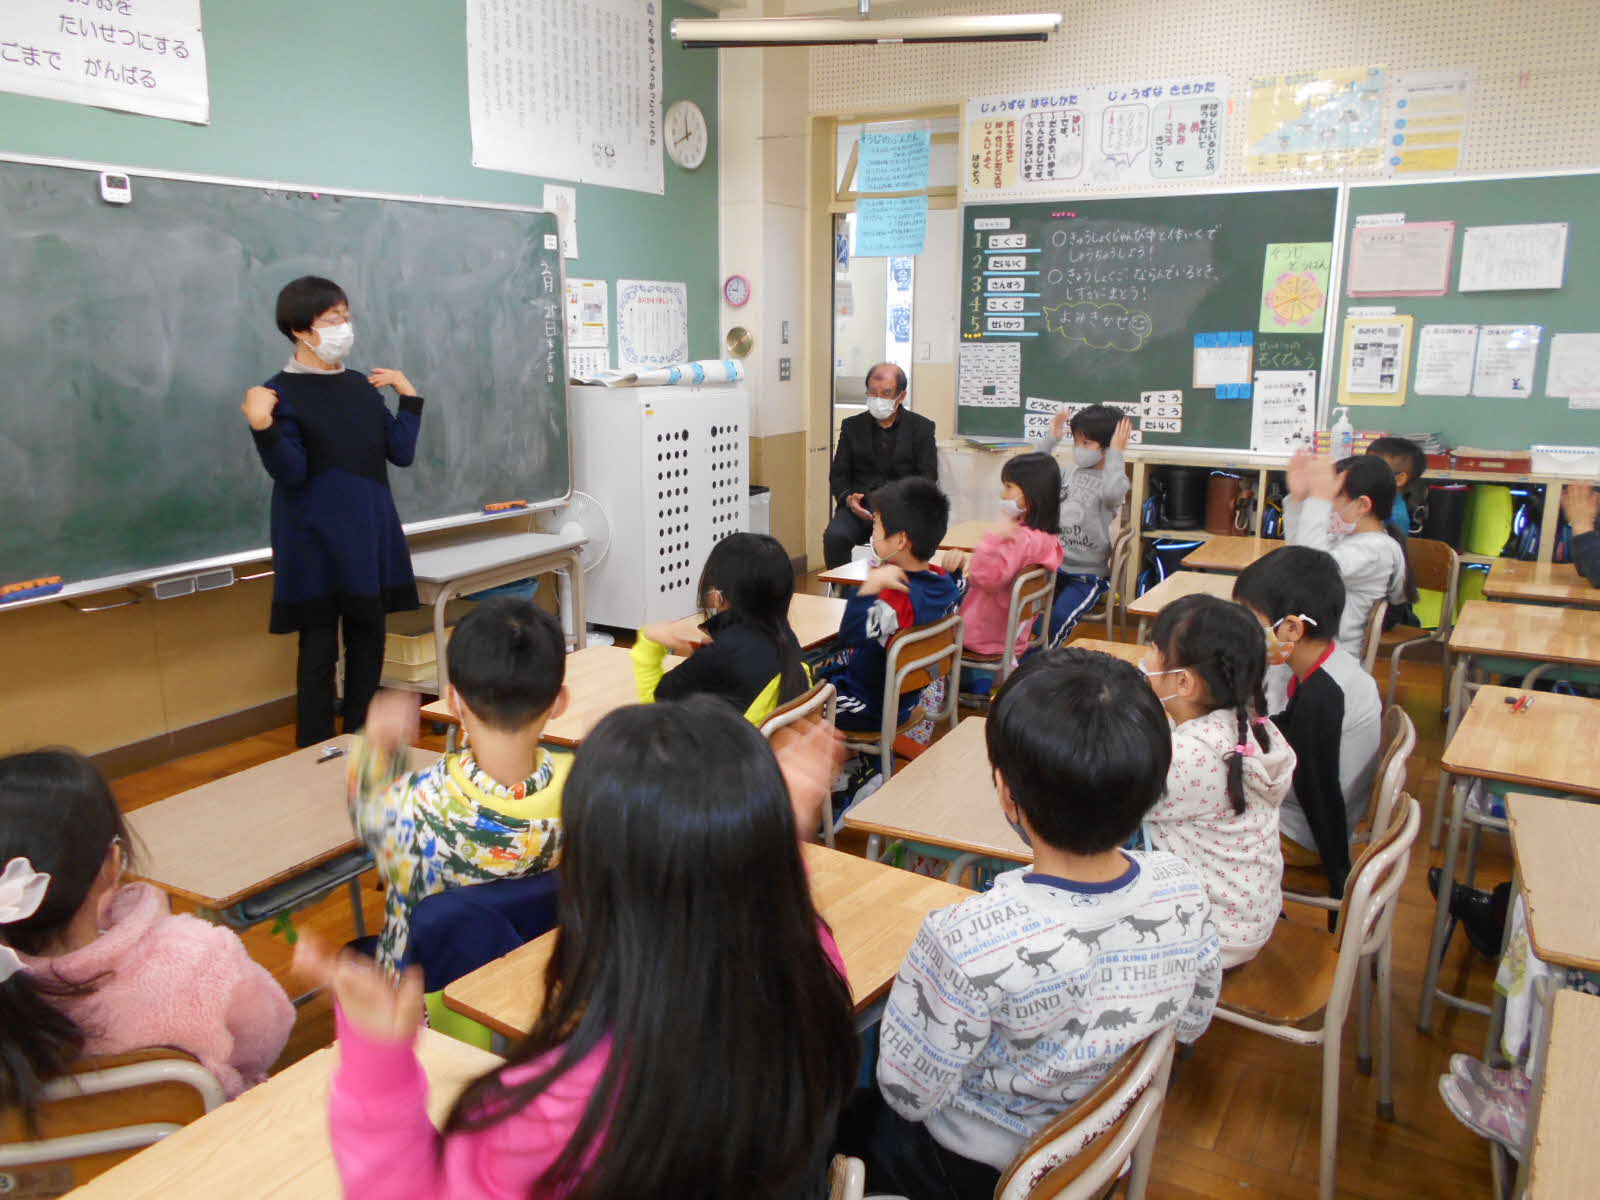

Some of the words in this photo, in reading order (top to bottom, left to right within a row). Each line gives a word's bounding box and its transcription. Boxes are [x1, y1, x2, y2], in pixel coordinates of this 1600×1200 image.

[59, 14, 189, 58] たいせつにする
[84, 57, 157, 88] がんばる
[1108, 87, 1163, 101] じょうずな
[1170, 82, 1215, 96] ききかた
[981, 99, 1026, 113] じょうずな
[1031, 95, 1077, 108] はなしかた
[974, 233, 982, 248] 1
[990, 237, 1024, 248] こくご
[973, 255, 982, 270] 2
[992, 259, 1023, 269] たいいく
[972, 276, 982, 292] 3
[991, 280, 1022, 290] さんすう
[970, 297, 982, 312] 4
[989, 300, 1022, 310] こくご
[970, 317, 980, 331] 5
[991, 320, 1021, 329] せいかつ
[1058, 312, 1129, 330] よみきかせ
[1143, 394, 1180, 404] ずこう
[1030, 401, 1057, 412] どうとく
[1143, 407, 1180, 417] ずこう
[1028, 416, 1051, 426] どうと
[1144, 421, 1177, 431] たいいく
